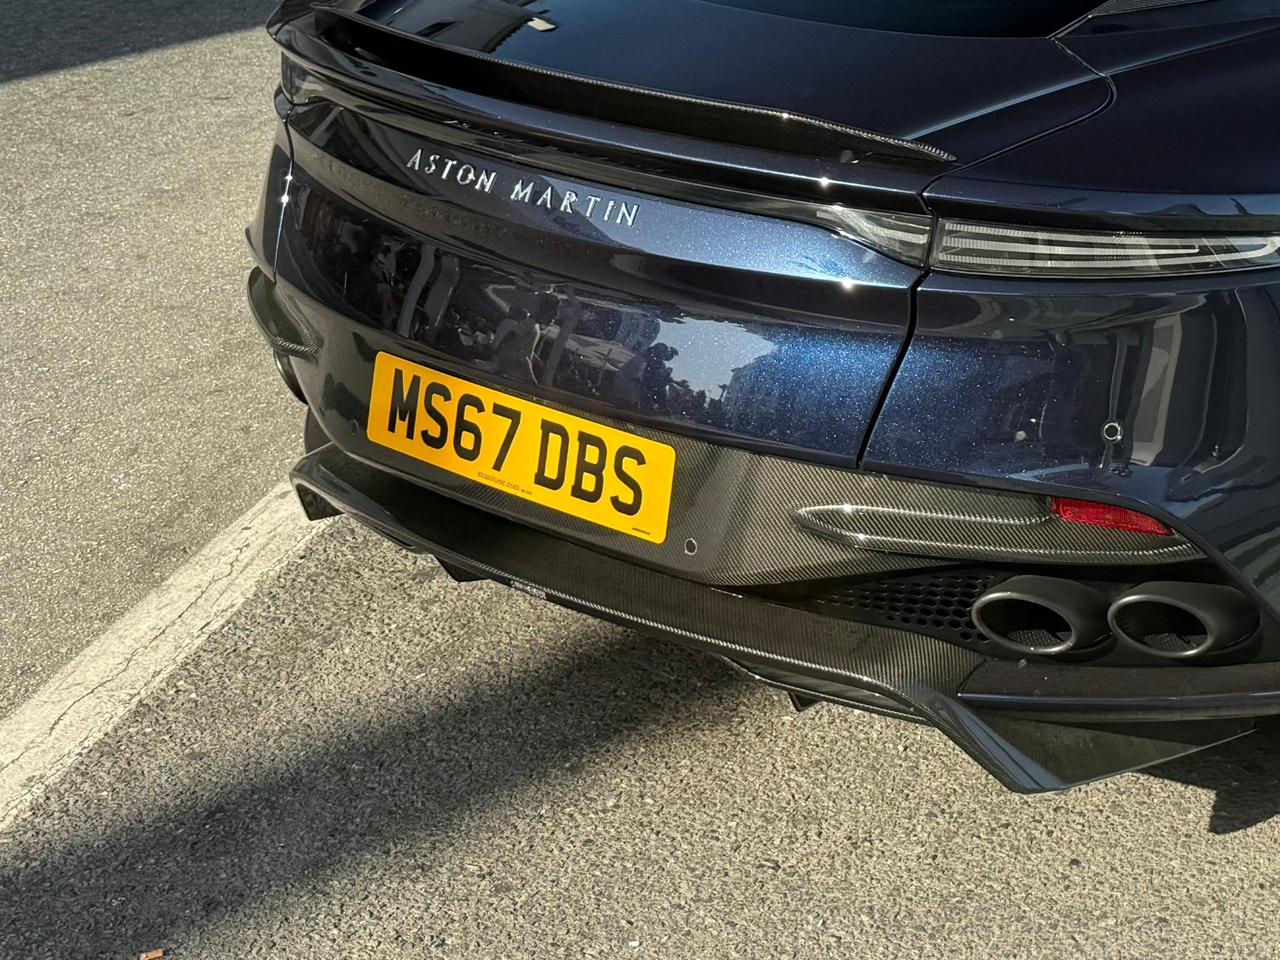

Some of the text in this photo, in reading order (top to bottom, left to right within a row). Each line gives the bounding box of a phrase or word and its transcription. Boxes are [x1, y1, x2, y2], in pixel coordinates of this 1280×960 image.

[406, 148, 639, 228] ASTON MARTIN
[387, 368, 646, 517] MS67 DBS
